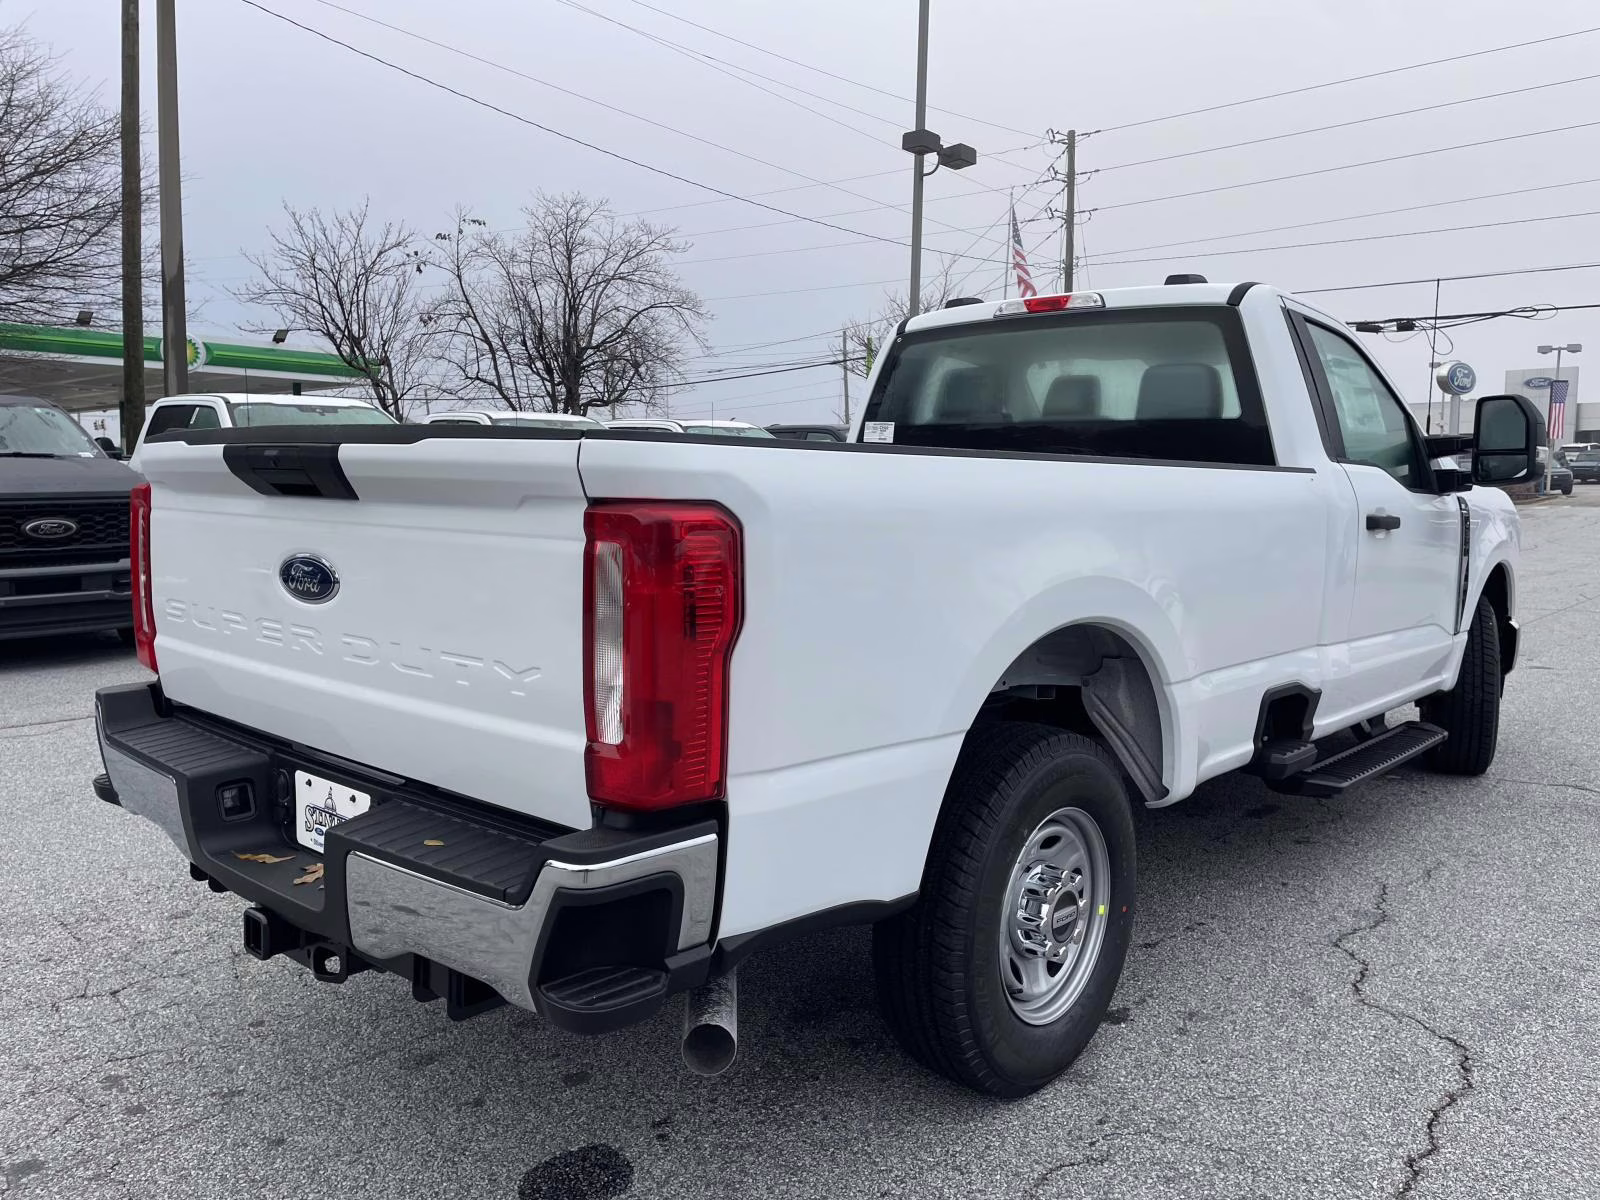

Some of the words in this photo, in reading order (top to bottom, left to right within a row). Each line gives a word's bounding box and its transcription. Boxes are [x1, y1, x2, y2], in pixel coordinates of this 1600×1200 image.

[1454, 367, 1473, 388] Ford
[288, 562, 321, 593] Ford
[164, 598, 324, 656] SUPER
[341, 632, 543, 697] DUTY
